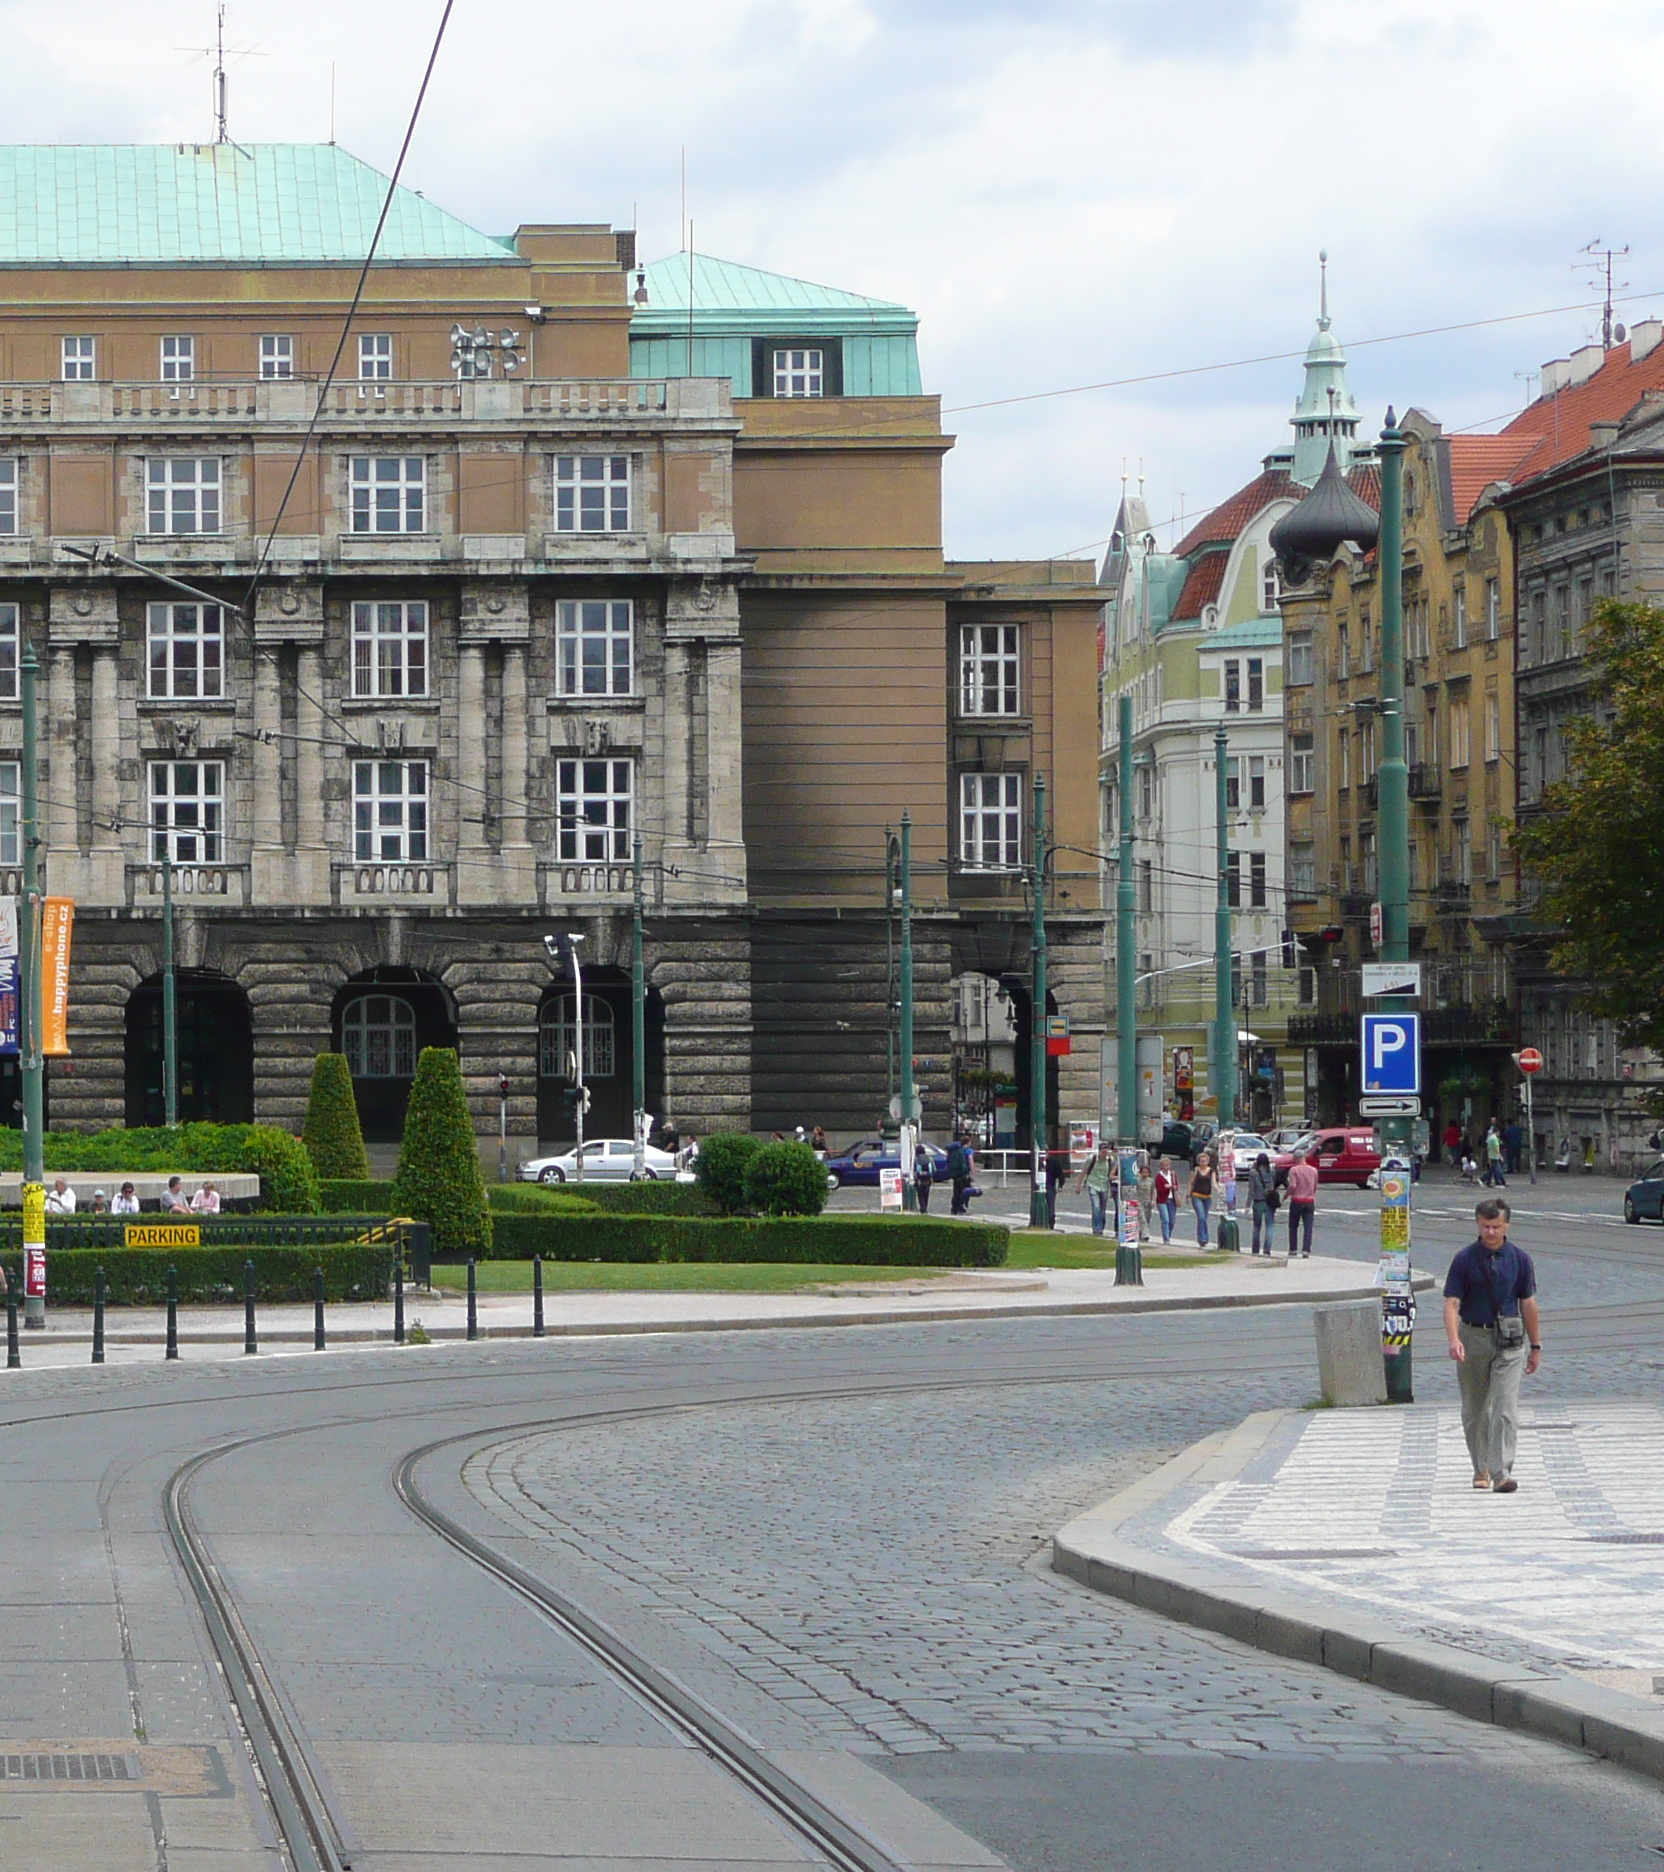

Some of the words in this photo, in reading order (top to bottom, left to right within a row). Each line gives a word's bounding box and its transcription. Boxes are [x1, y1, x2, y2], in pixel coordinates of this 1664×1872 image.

[43, 904, 58, 952] e-shop
[1373, 1024, 1406, 1068] P
[128, 1228, 196, 1244] PARKING
